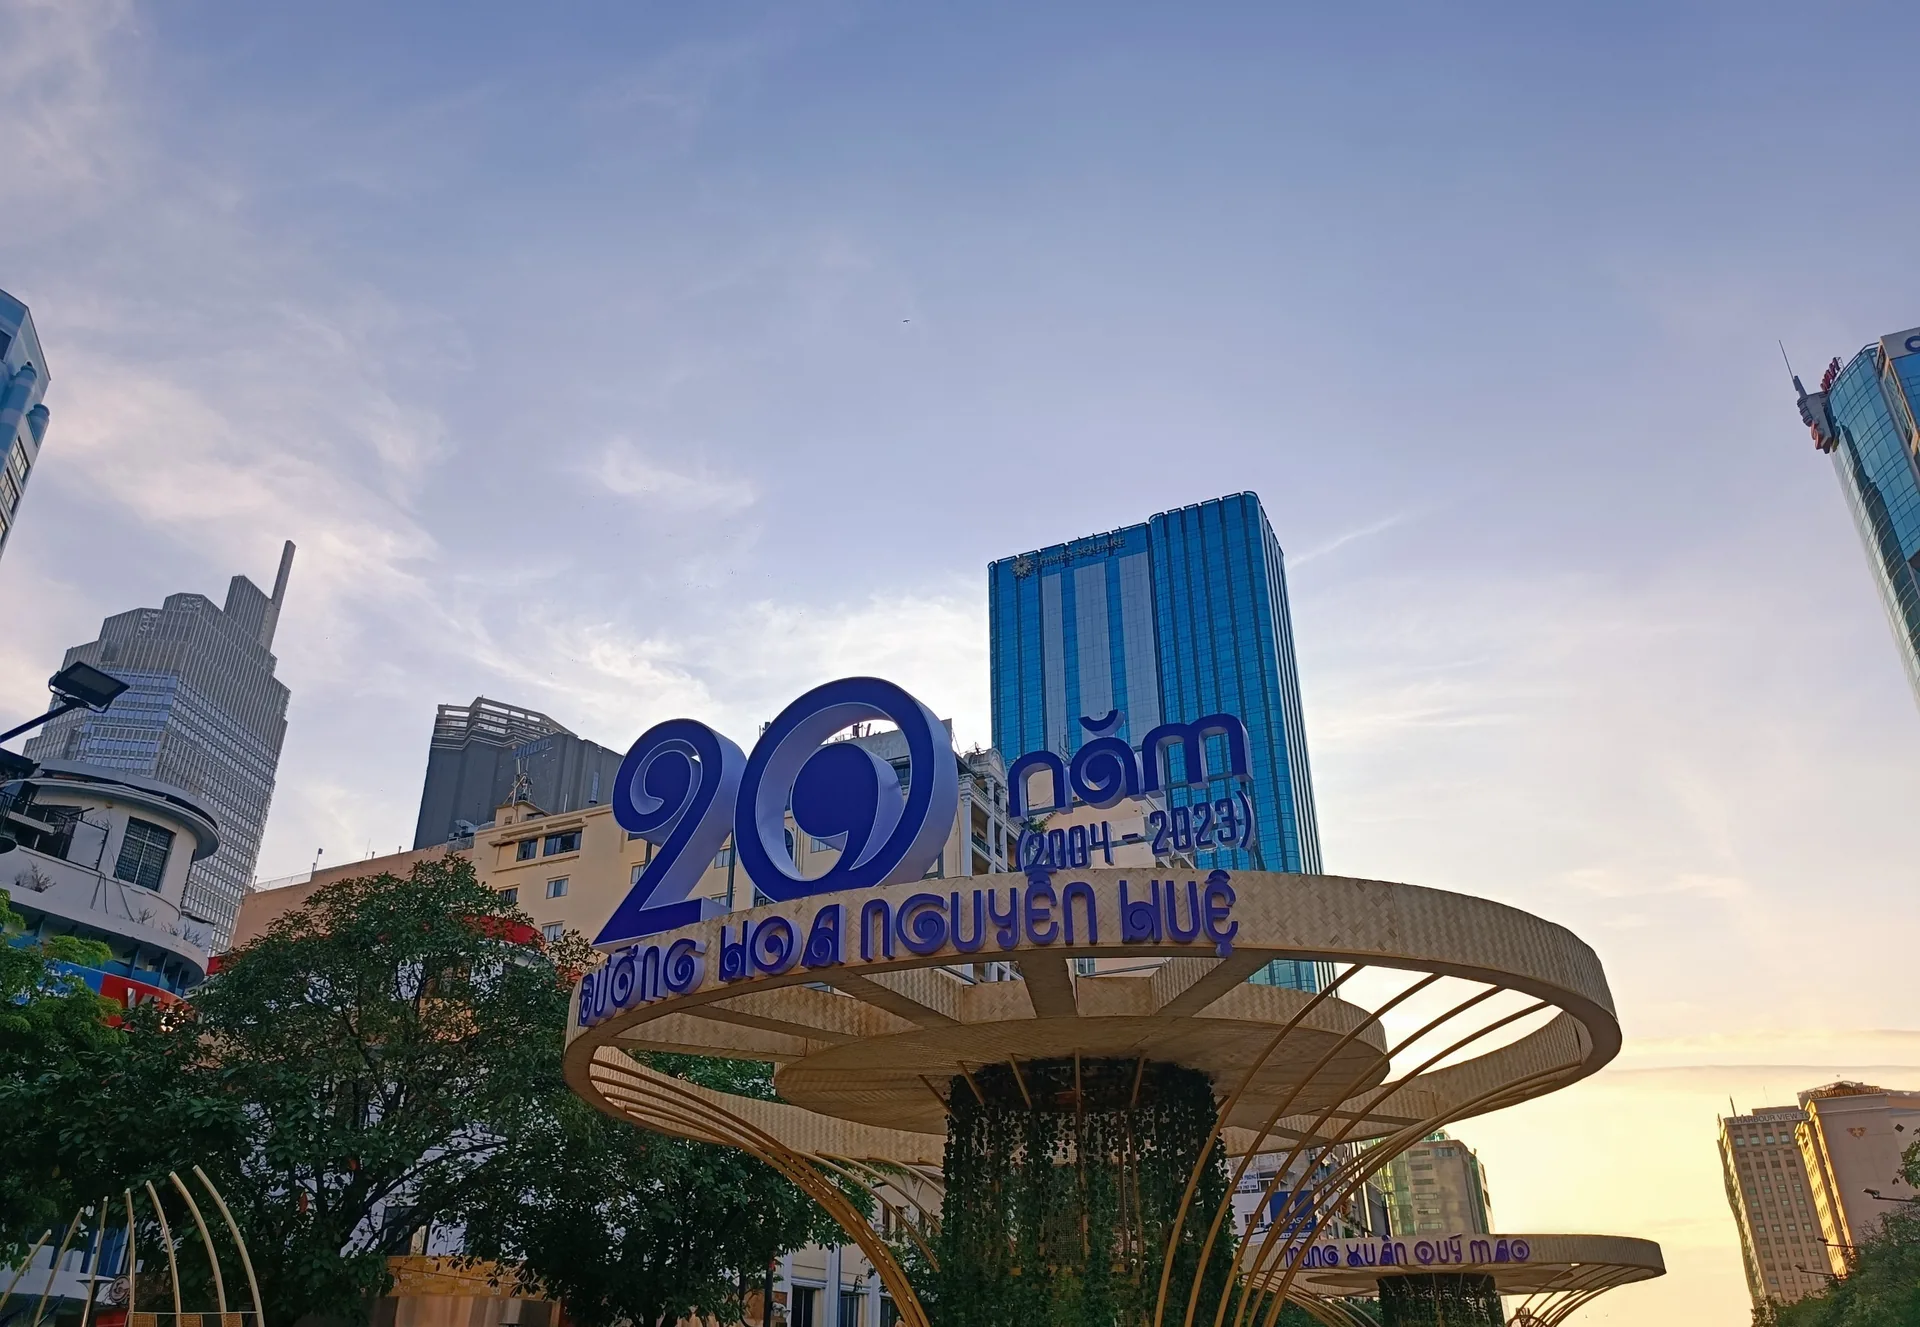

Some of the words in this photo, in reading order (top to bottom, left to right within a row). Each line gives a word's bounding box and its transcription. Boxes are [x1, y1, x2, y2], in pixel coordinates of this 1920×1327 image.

[1077, 537, 1125, 556] SQUARE
[592, 676, 957, 946] 20
[1149, 790, 1256, 858] 2023)
[719, 904, 848, 982] HOA
[1777, 1112, 1798, 1121] VIEW
